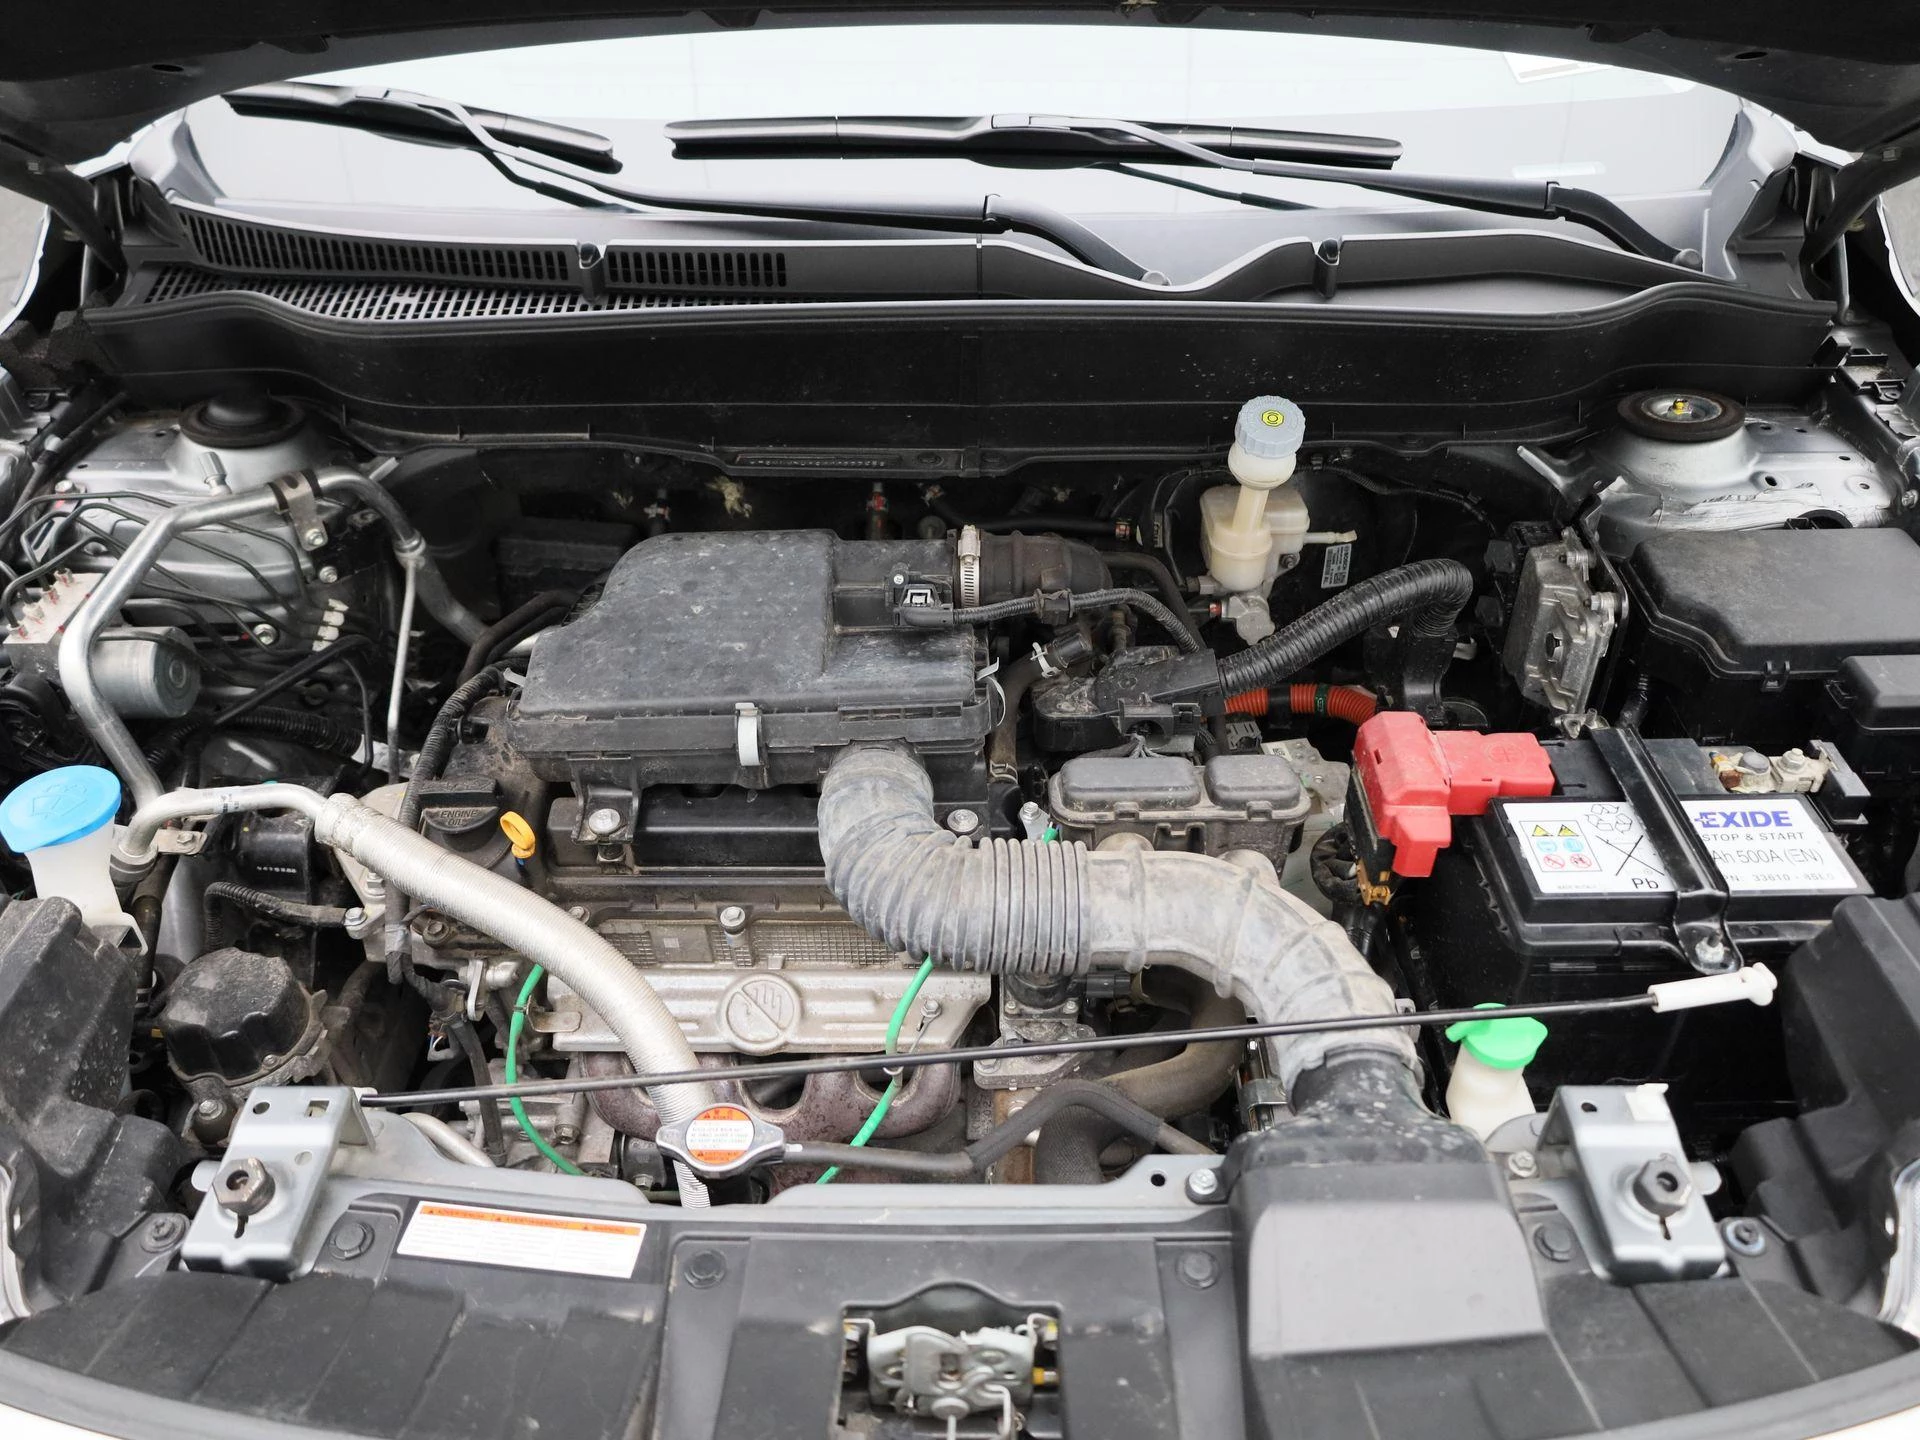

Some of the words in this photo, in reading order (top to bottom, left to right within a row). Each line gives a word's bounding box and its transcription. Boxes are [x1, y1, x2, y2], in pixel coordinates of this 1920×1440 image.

[440, 810, 479, 818] ENGINE
[1694, 811, 1792, 828] EXIDE
[1702, 833, 1739, 841] STOP
[1745, 832, 1754, 841] &
[1760, 832, 1804, 841] START
[1736, 849, 1783, 864] 500A
[1783, 848, 1823, 866] (EN)
[1632, 878, 1659, 889] Pb
